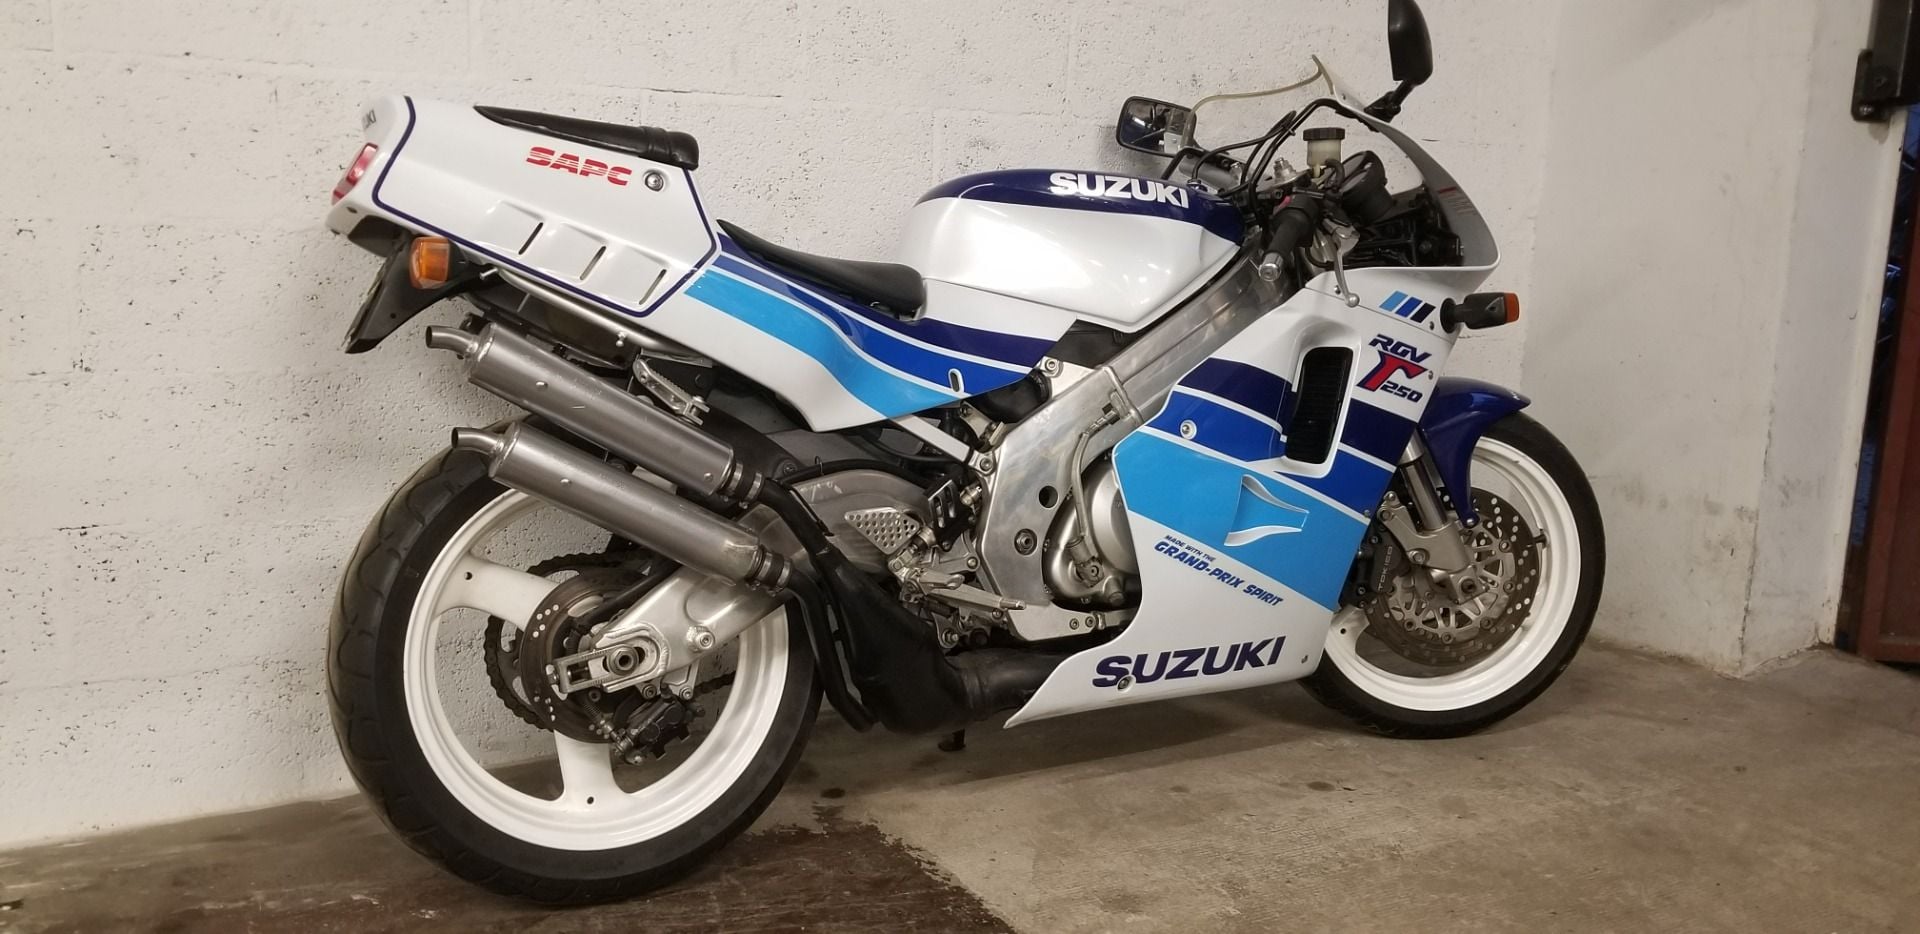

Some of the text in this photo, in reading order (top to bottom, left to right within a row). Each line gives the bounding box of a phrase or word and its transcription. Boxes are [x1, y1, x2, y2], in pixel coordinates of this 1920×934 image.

[526, 146, 632, 186] SAPC
[1049, 171, 1189, 209] SUZUKI
[1368, 333, 1432, 364] RGV
[1380, 380, 1423, 403] 250
[1165, 534, 1216, 562] MADE WITH THE
[1154, 541, 1284, 606] GRAND-PRIX SPIRIT
[1092, 635, 1286, 688] SUZUKI
